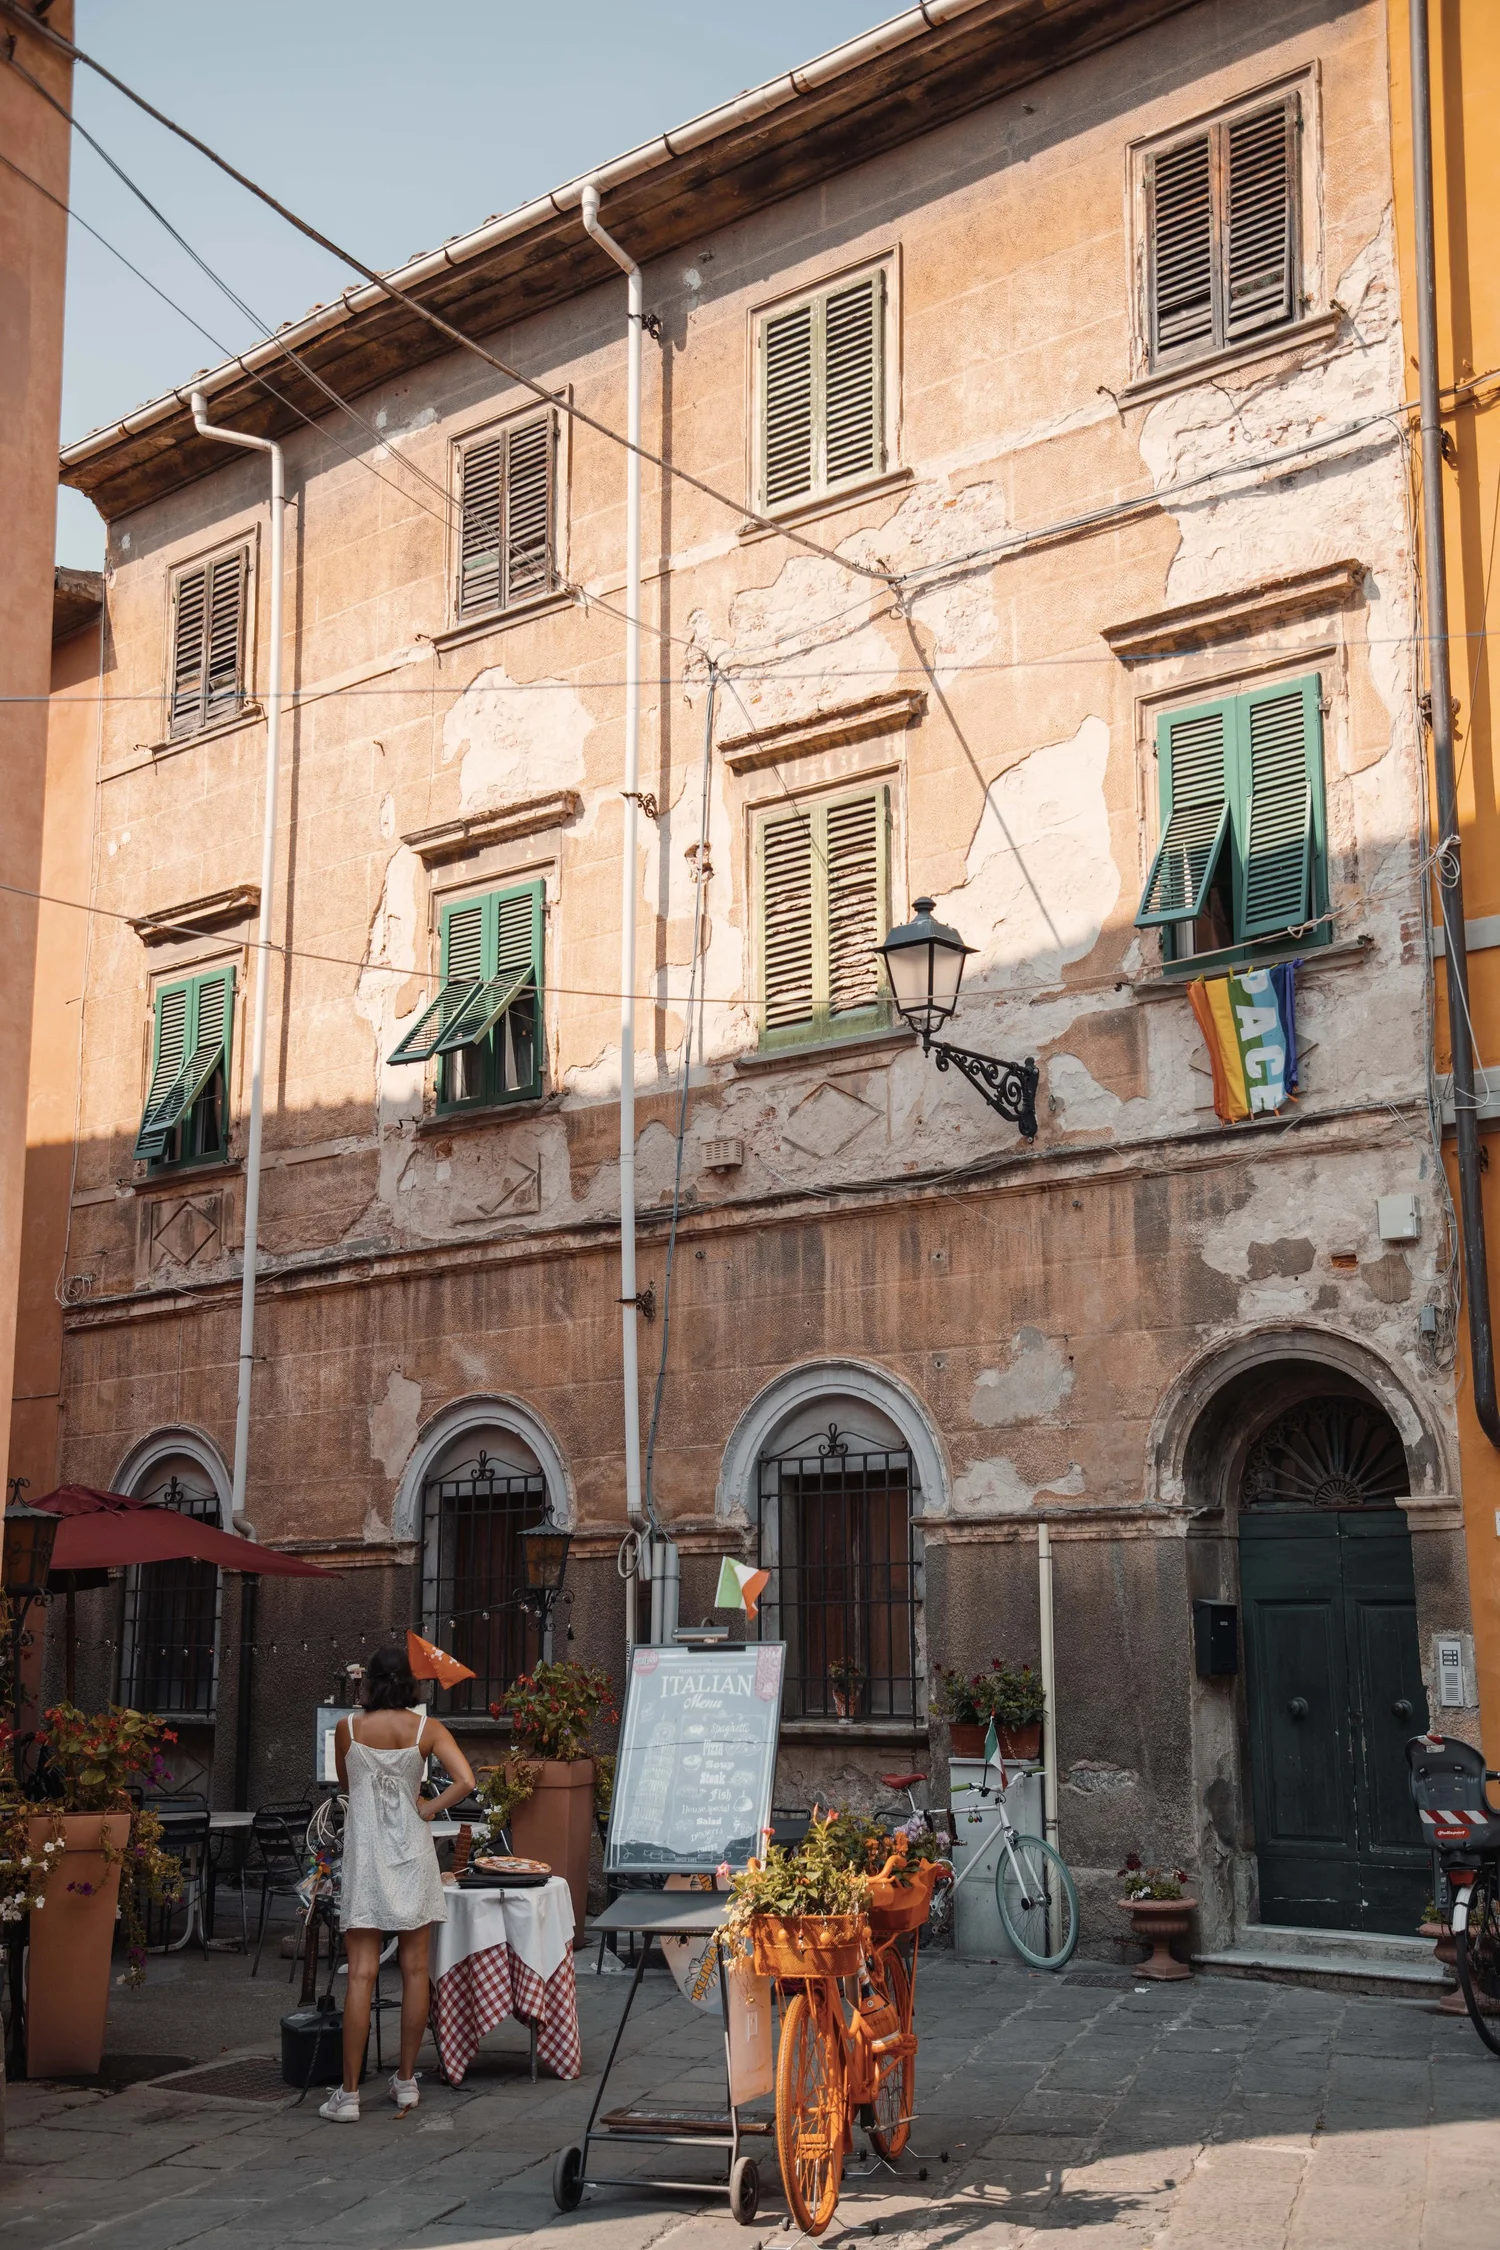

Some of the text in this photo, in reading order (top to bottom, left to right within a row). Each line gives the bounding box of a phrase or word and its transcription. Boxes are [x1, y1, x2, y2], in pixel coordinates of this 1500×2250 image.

[1231, 969, 1286, 1114] PACE
[660, 1674, 754, 1698] ITALIAN
[683, 1693, 723, 1709] Menu
[704, 1760, 734, 1771] Soup
[699, 1771, 726, 1785] Steak
[708, 1787, 732, 1802] Fish
[682, 1803, 706, 1815] House
[696, 1816, 722, 1826] Salad
